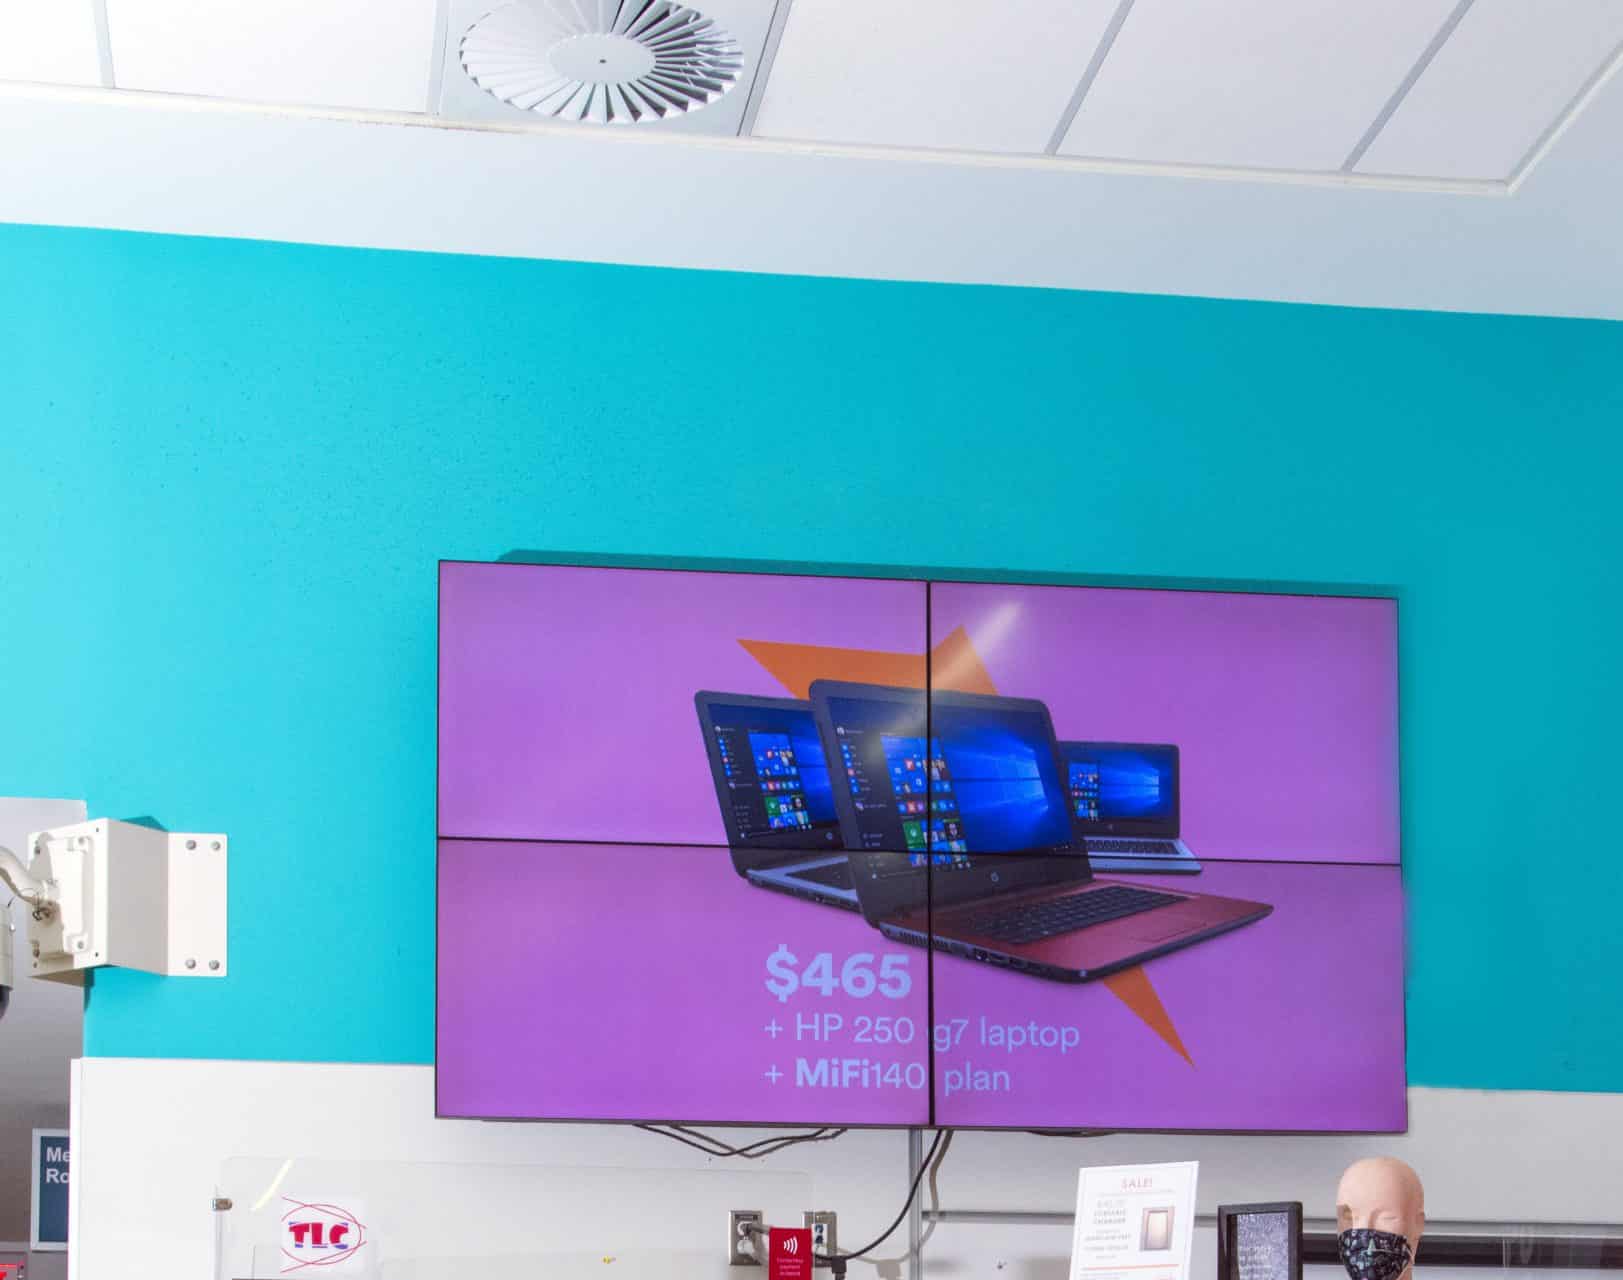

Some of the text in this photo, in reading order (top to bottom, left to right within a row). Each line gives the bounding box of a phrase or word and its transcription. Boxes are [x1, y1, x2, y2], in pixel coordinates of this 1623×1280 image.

[765, 944, 912, 1003] $465
[796, 1012, 843, 1042] HP
[853, 1016, 915, 1044] 250
[932, 1019, 969, 1052] g7
[980, 1016, 1080, 1053] laptop
[796, 1058, 925, 1089] MiFi140
[943, 1061, 1011, 1096] plan
[46, 1147, 70, 1162] Me
[288, 1221, 349, 1250] TLC
